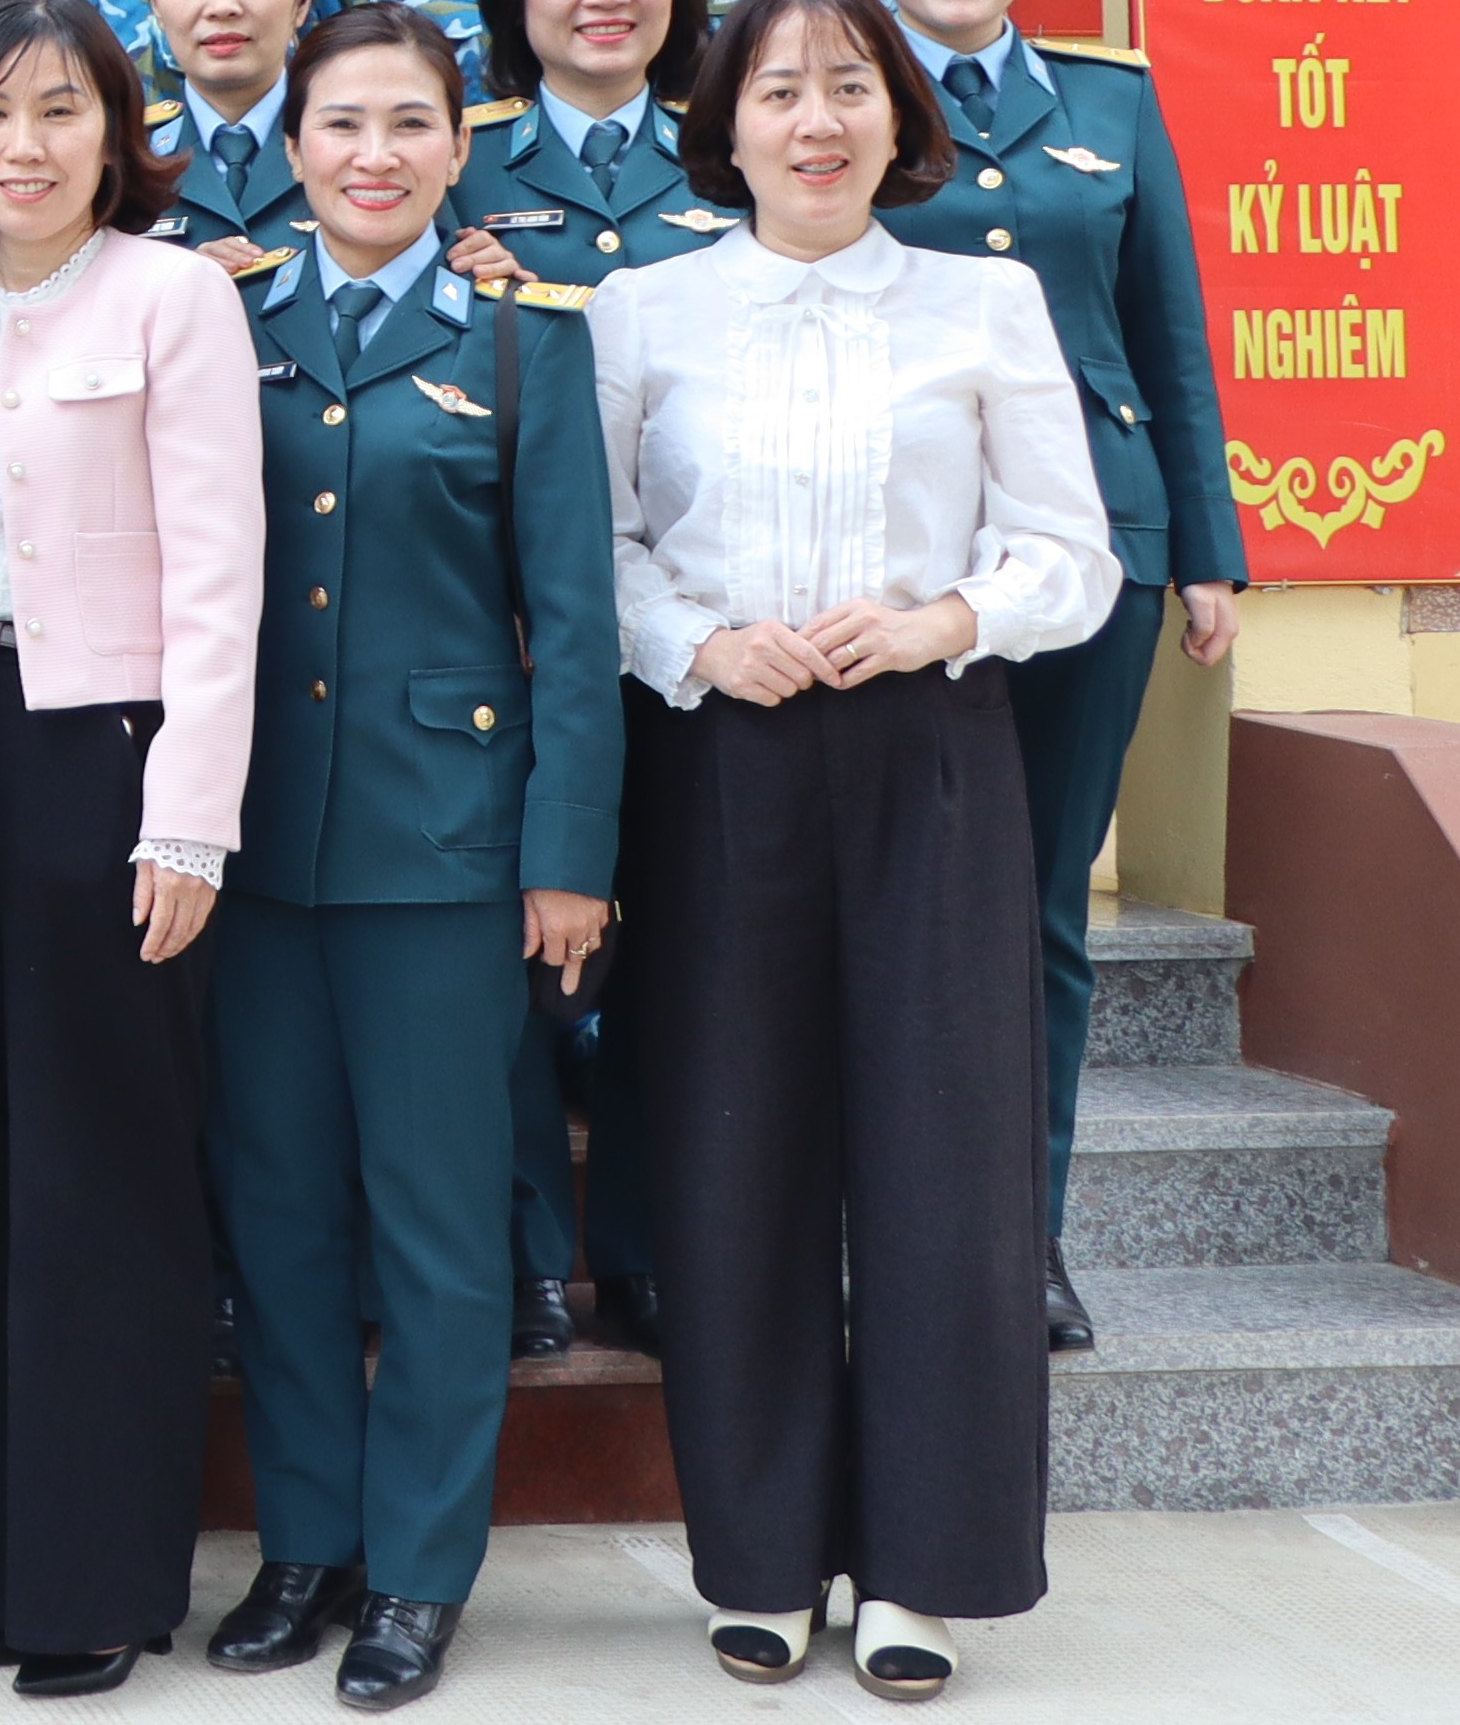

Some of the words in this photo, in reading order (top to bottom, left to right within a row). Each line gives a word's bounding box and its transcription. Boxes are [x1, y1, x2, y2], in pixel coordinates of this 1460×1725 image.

[1272, 32, 1352, 129] TỐT
[1229, 159, 1286, 254] KỶ
[1298, 168, 1404, 270] LUẬT
[1233, 293, 1408, 380] NGHIÊM
